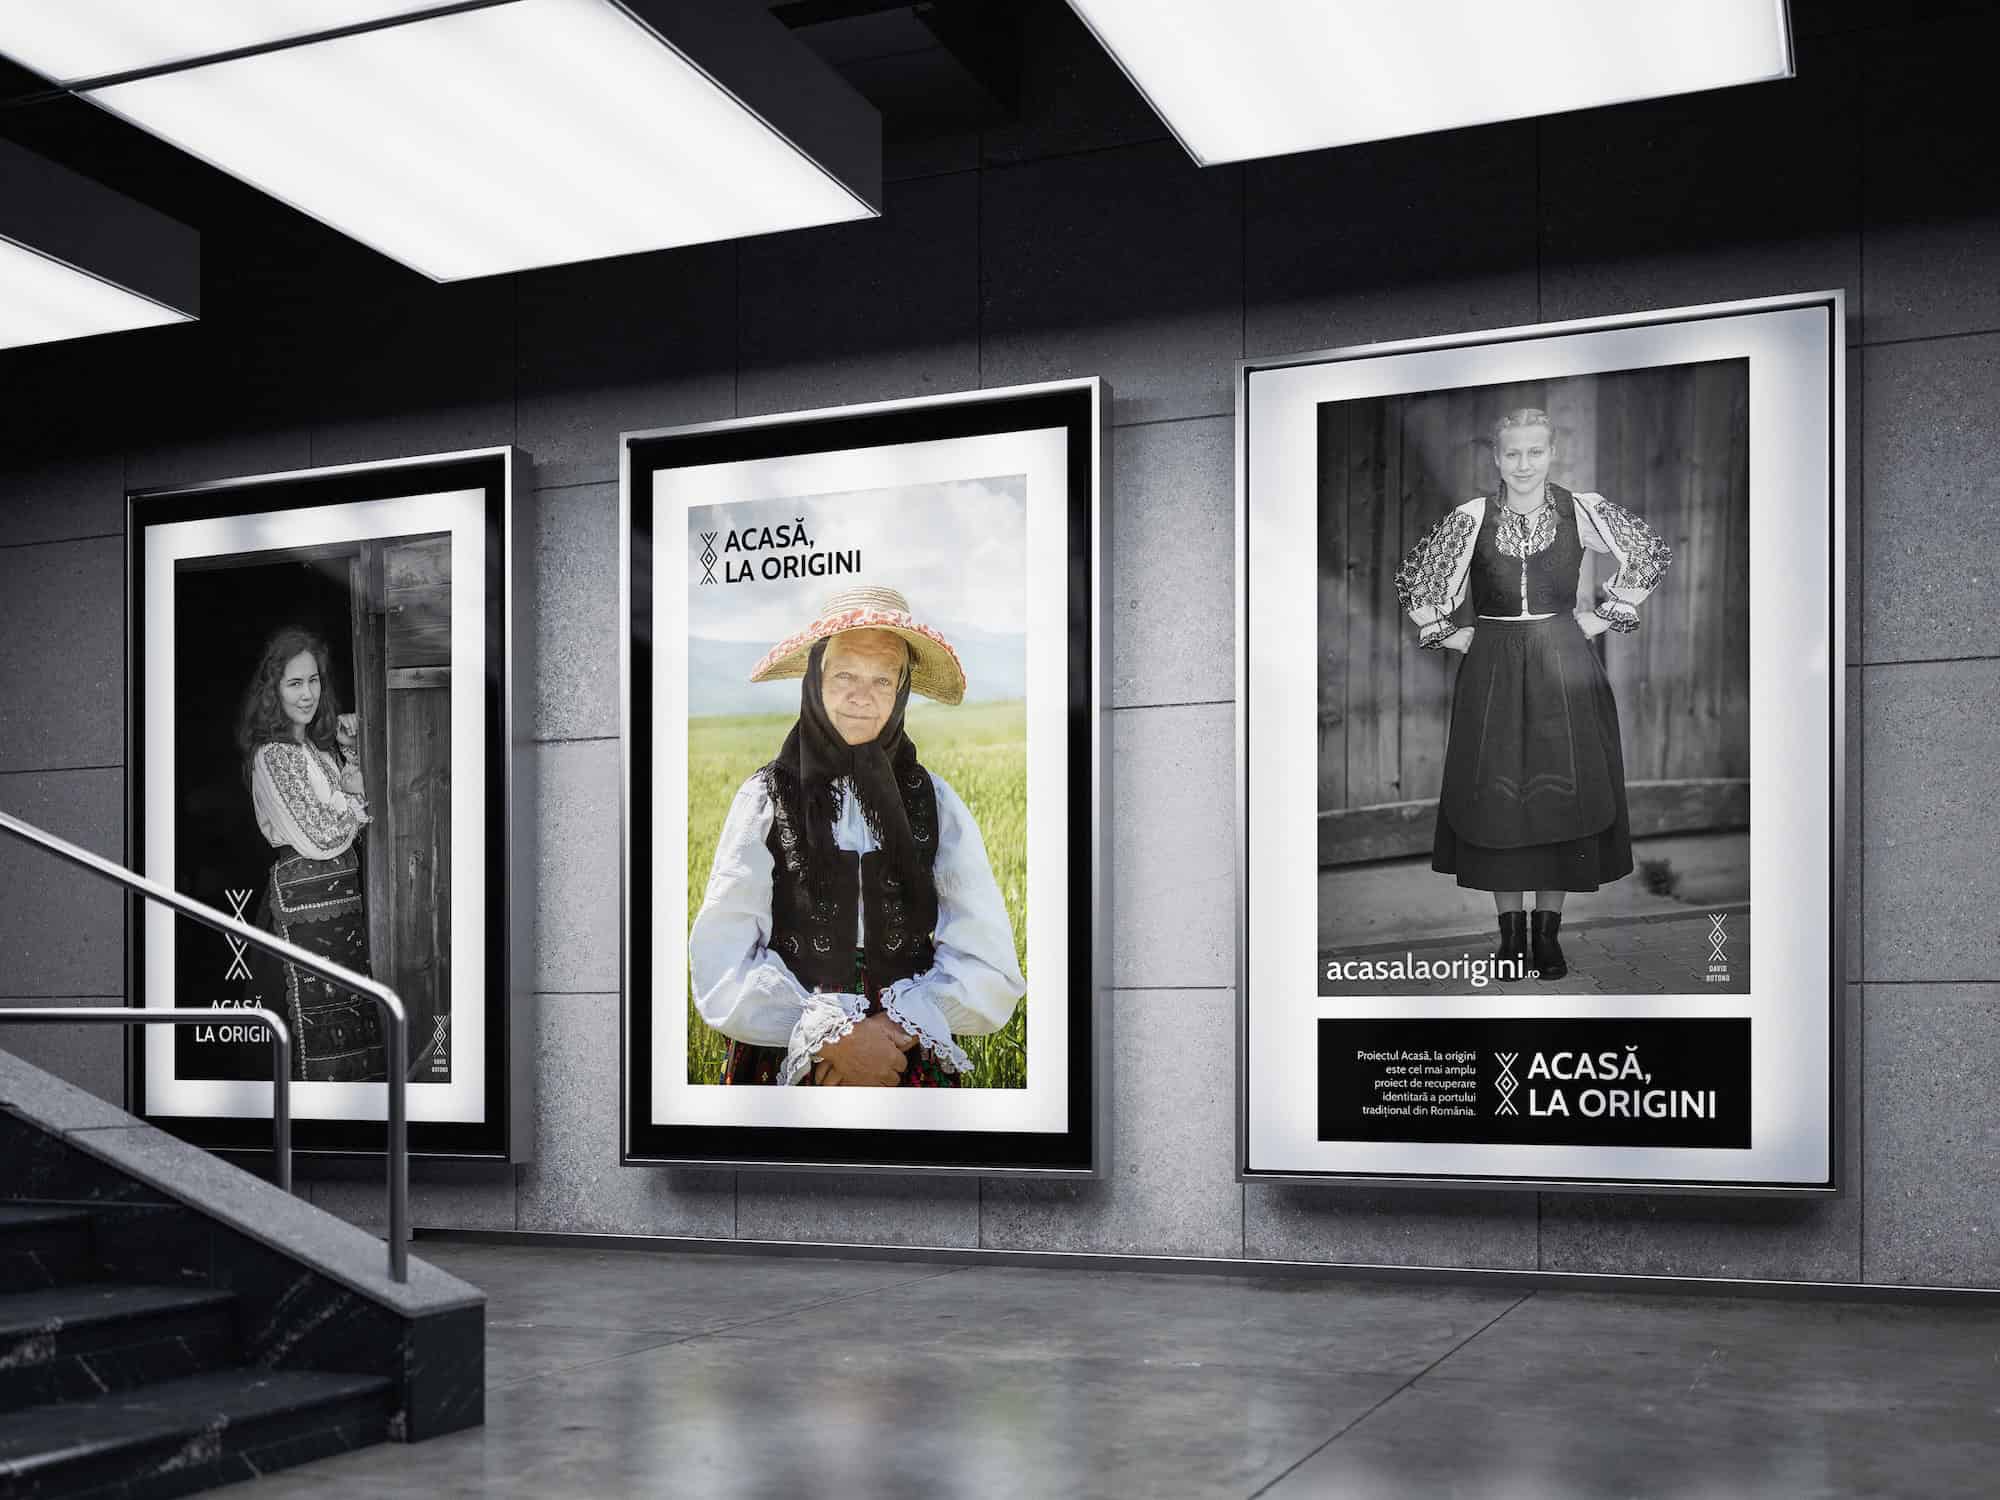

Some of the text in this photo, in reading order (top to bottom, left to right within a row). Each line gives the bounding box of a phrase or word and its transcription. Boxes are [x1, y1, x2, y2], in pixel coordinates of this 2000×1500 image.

[724, 517, 815, 553] ACASĂ,
[725, 549, 861, 584] LA ORIGINI
[1326, 952, 1540, 987] acasalaorigini.ro
[195, 1025, 215, 1043] LA
[1357, 1050, 1399, 1061] Proiectul
[1433, 1050, 1443, 1061] la
[1445, 1050, 1477, 1064] origini
[1528, 1045, 1652, 1084] ACASĂ,
[1385, 1064, 1476, 1077] este cel mai amplu
[1374, 1078, 1477, 1090] proiect de recuperare
[1383, 1091, 1477, 1104] identitară a portului
[1528, 1089, 1716, 1119] LA ORIGINI
[1412, 1105, 1428, 1115] din
[1430, 1105, 1477, 1116] România.
